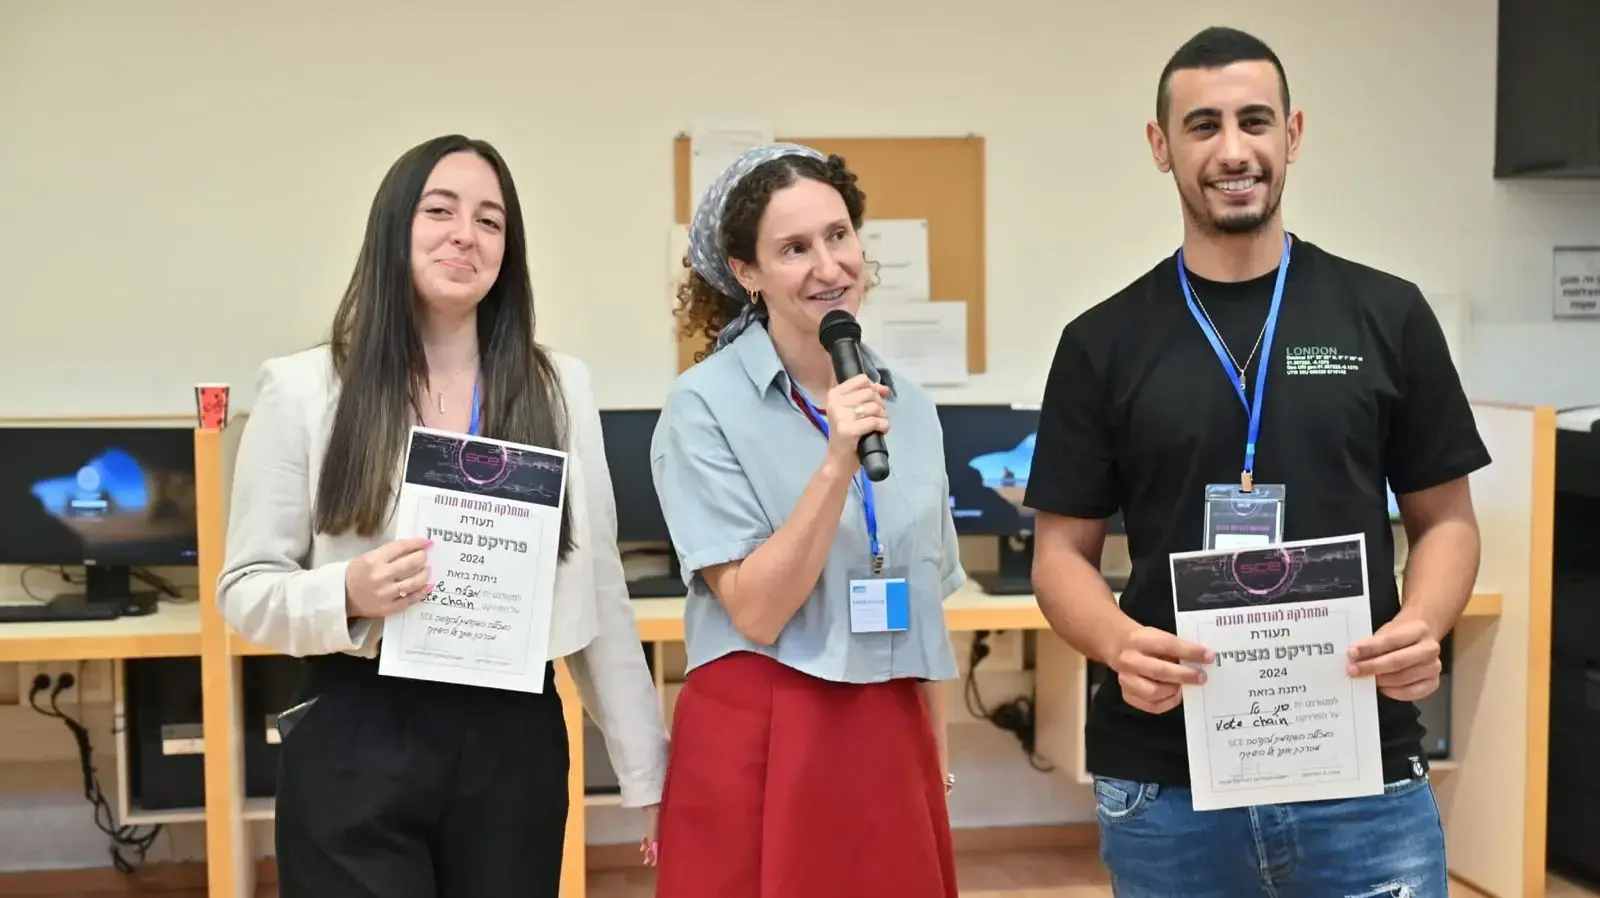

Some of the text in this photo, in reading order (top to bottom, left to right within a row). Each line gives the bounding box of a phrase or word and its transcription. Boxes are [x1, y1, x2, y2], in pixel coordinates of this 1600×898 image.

[1286, 346, 1338, 355] LONDON
[460, 498, 492, 513] להנדסת
[494, 503, 530, 518] המחלקה
[460, 515, 494, 528] תעודת
[426, 527, 528, 553] פרויקט מצטיין
[459, 553, 485, 564] 2024
[447, 569, 498, 584] ניתנת בזאת
[440, 595, 475, 610] chain
[1215, 606, 1329, 627] המחלקה להנדסת תוכנה
[1250, 627, 1291, 640] תעודת
[1215, 641, 1335, 667] פרויקט מצטיין
[1259, 667, 1288, 679] 2024
[1248, 684, 1307, 698] ניתנת בזאת
[1252, 714, 1289, 728] chain
